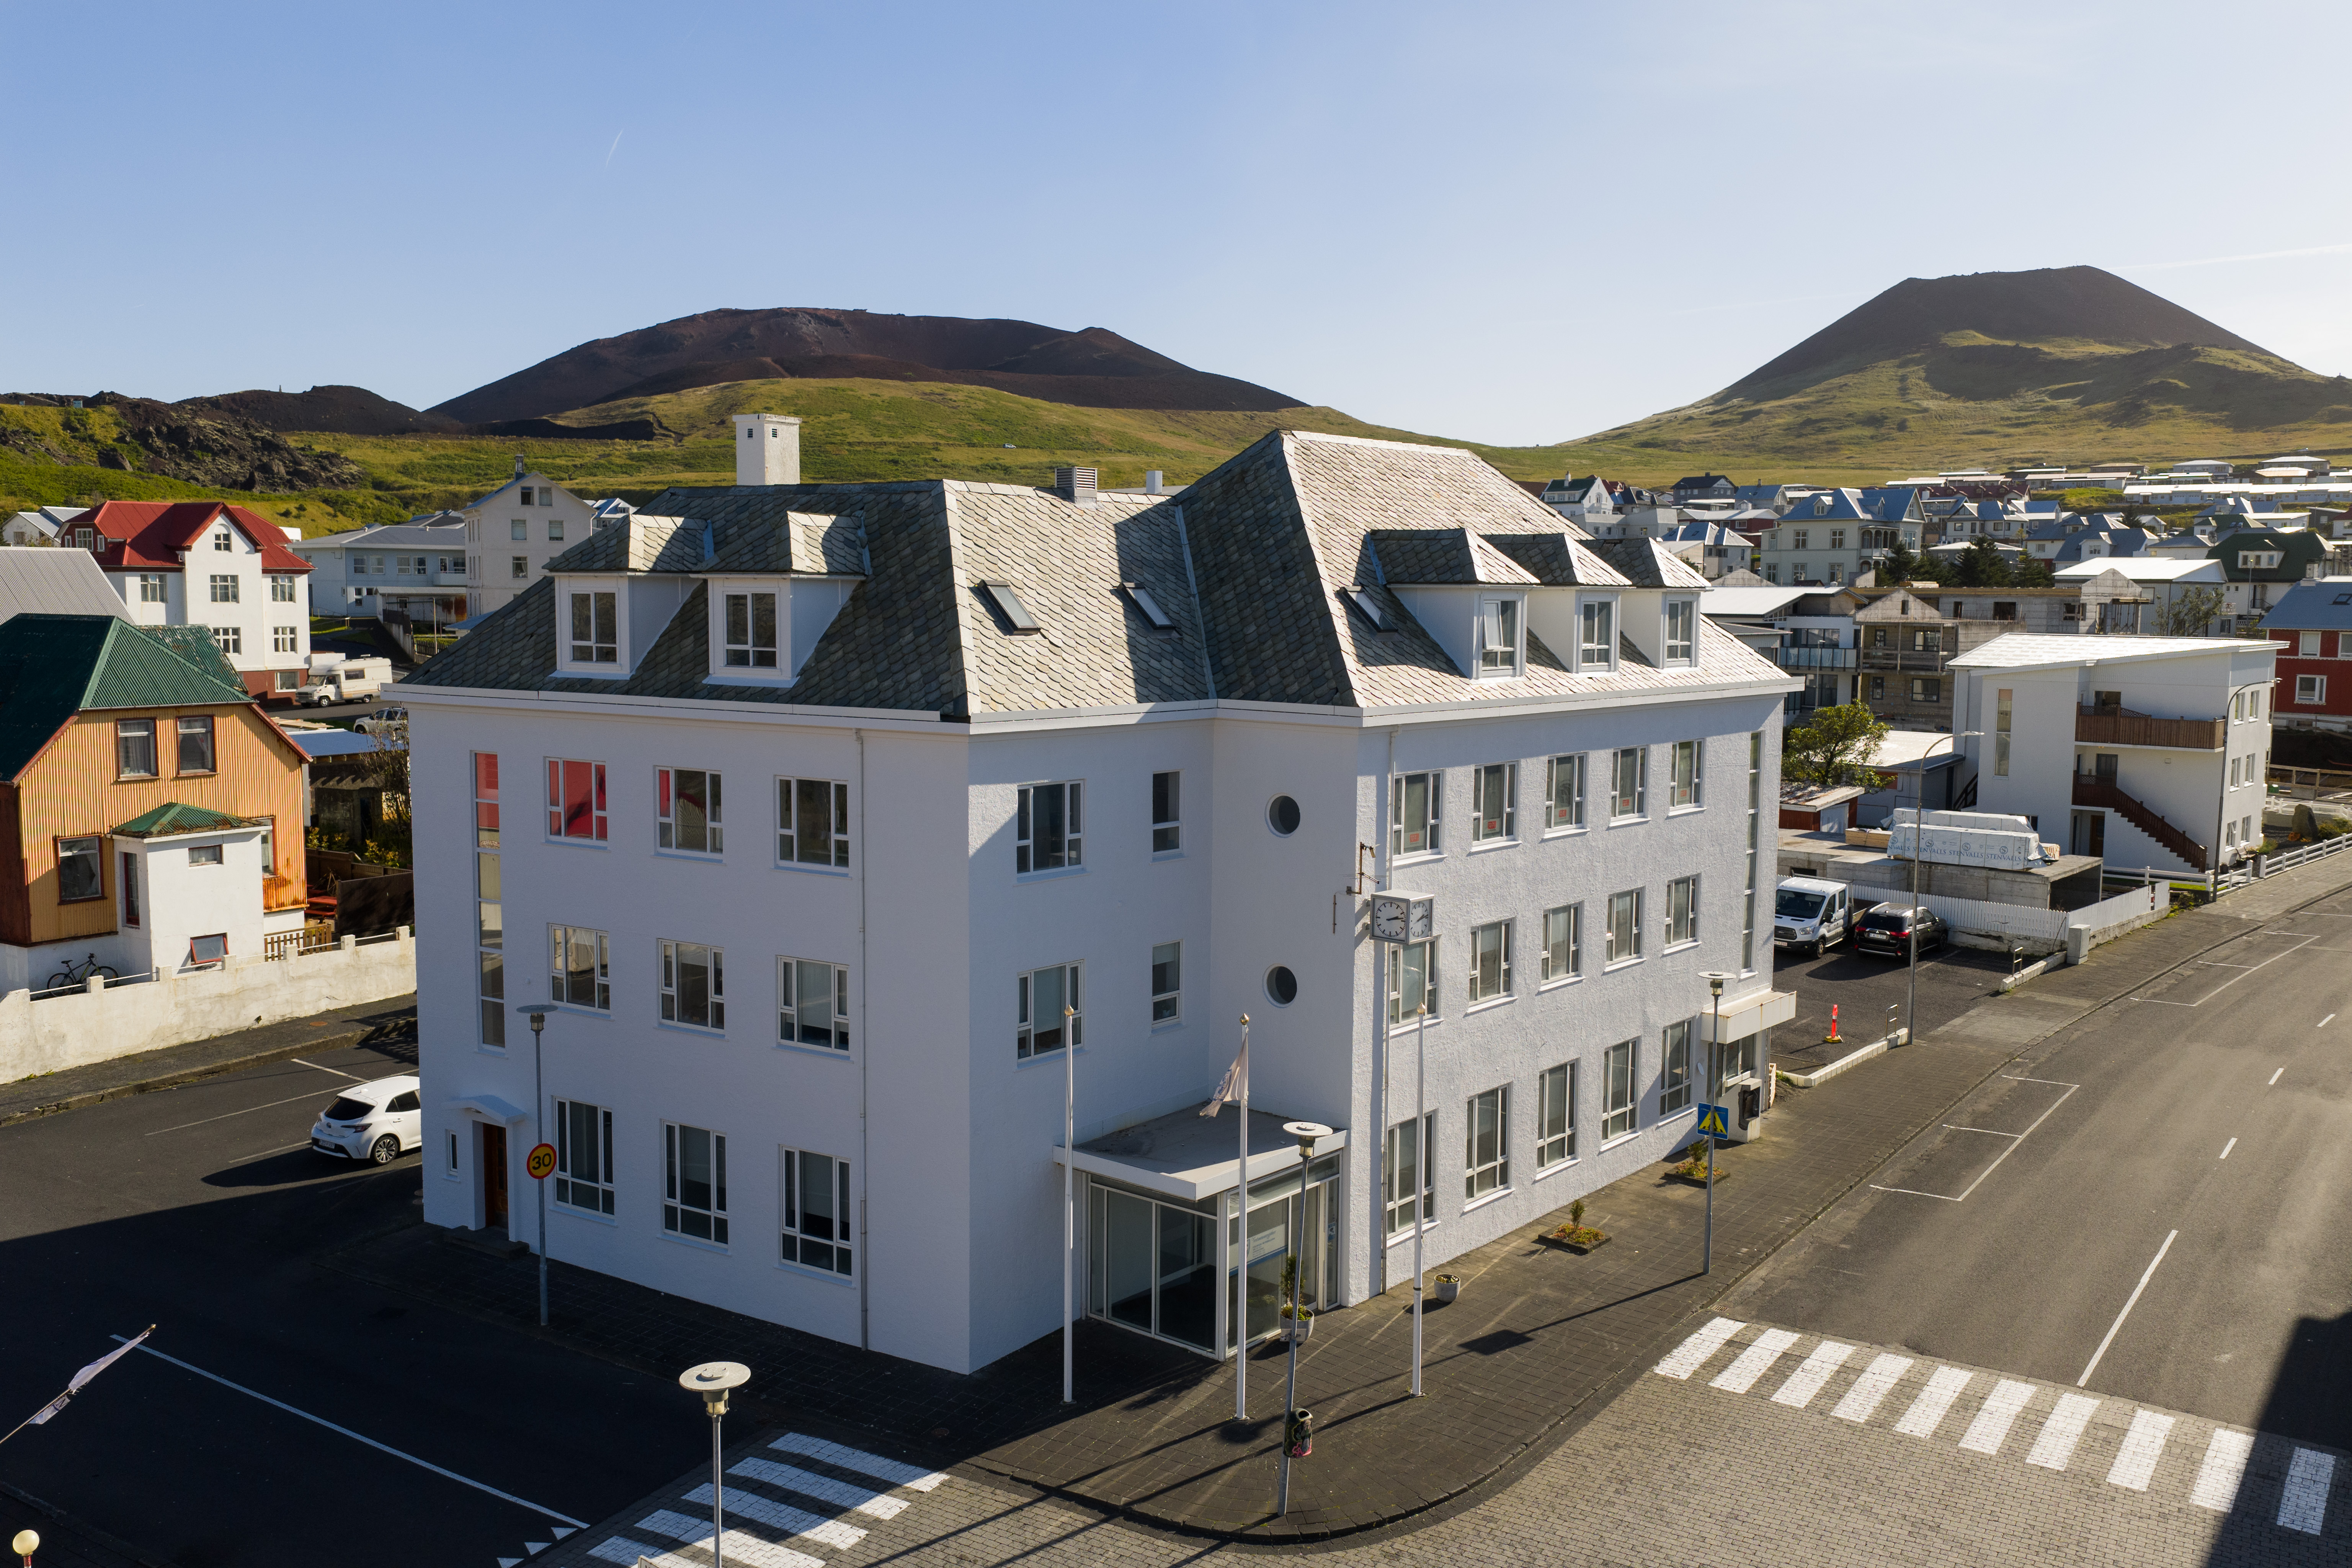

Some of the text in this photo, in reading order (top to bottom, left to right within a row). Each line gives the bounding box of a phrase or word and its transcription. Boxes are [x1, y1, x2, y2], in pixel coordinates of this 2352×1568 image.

[1949, 850, 1983, 858] STENVALLS
[1986, 853, 2021, 861] STENVALLS
[532, 1153, 552, 1170] 30
